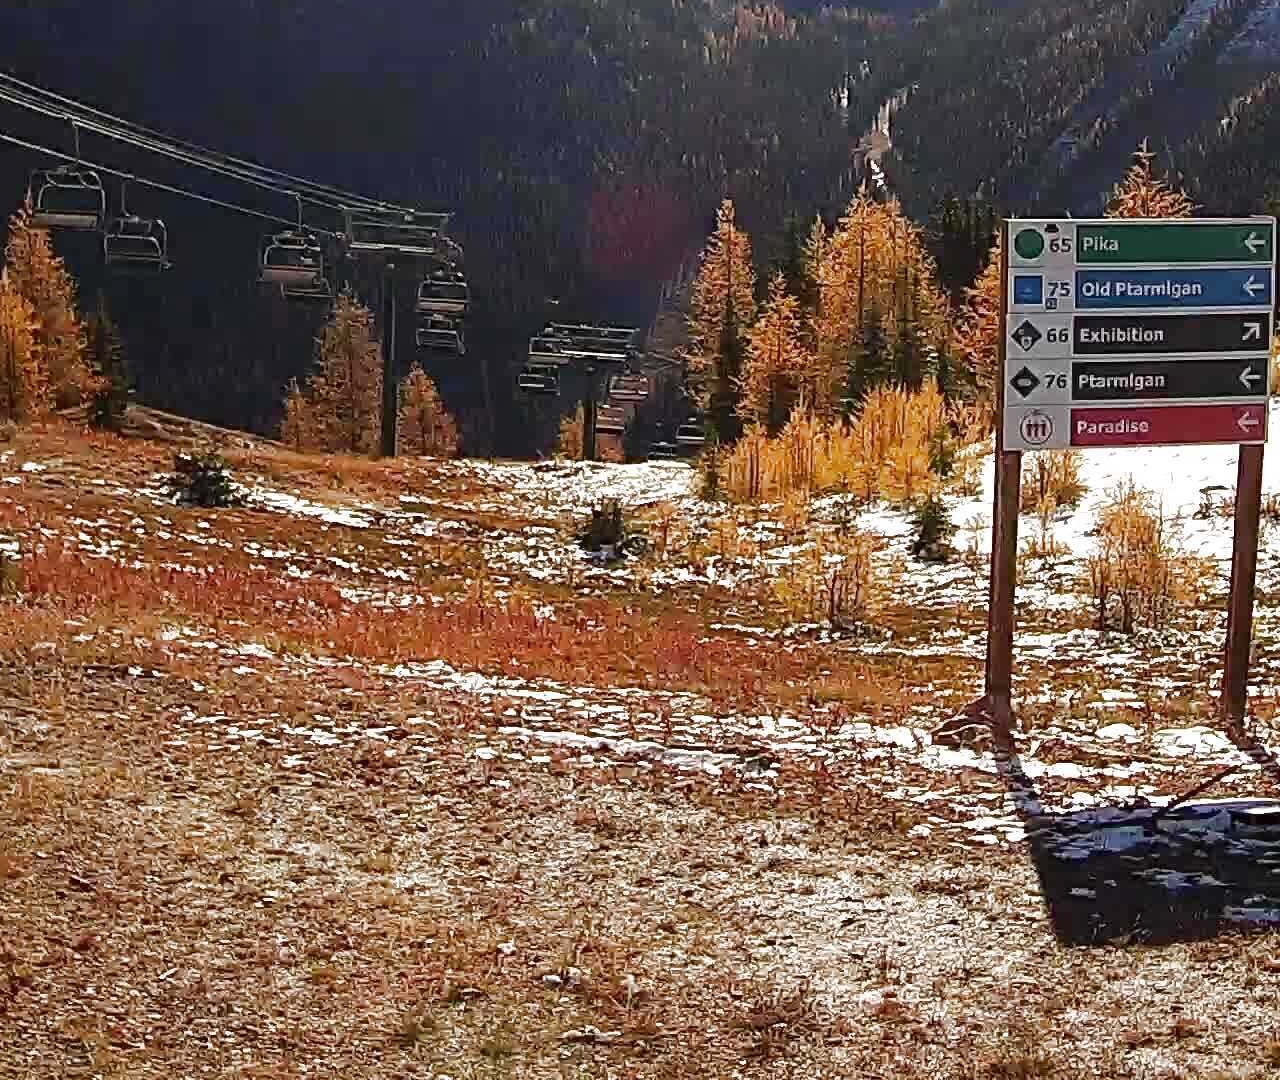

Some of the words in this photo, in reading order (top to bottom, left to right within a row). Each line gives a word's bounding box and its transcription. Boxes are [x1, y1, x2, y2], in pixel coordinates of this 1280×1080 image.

[1049, 238, 1072, 253] 65
[1082, 236, 1119, 252] Pika
[1047, 281, 1070, 297] 75
[1082, 282, 1111, 297] Old
[1115, 281, 1202, 298] Ptarmigan
[1046, 328, 1069, 343] 66
[1079, 326, 1164, 342] Exhibition
[1045, 374, 1067, 389] 76
[1078, 372, 1165, 391] Ptarmigan
[1076, 420, 1149, 435] Paradise
